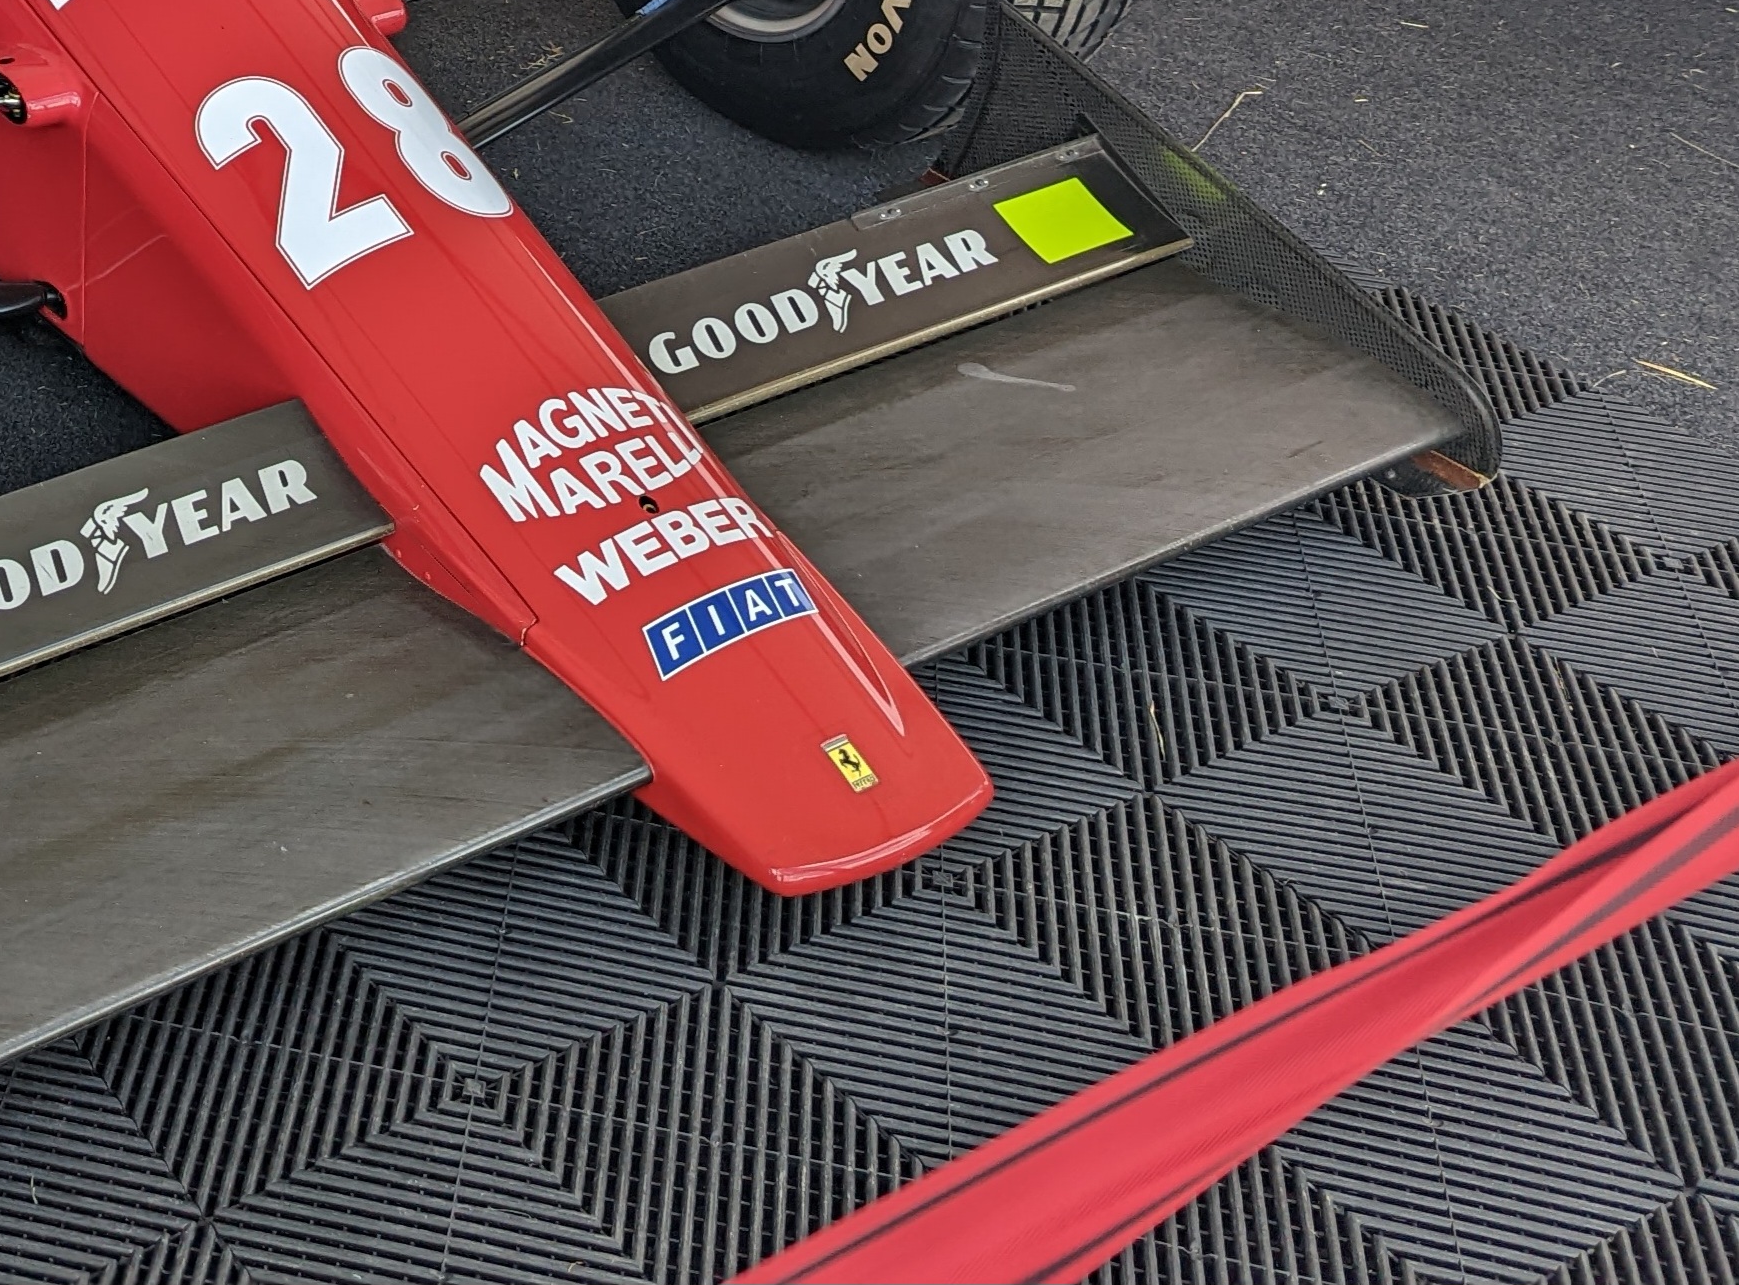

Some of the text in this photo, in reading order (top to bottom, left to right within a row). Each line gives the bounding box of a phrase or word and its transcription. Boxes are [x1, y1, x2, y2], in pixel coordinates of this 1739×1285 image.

[194, 45, 514, 291] 28
[553, 496, 775, 606] WEBER
[656, 574, 808, 669] FIAT
